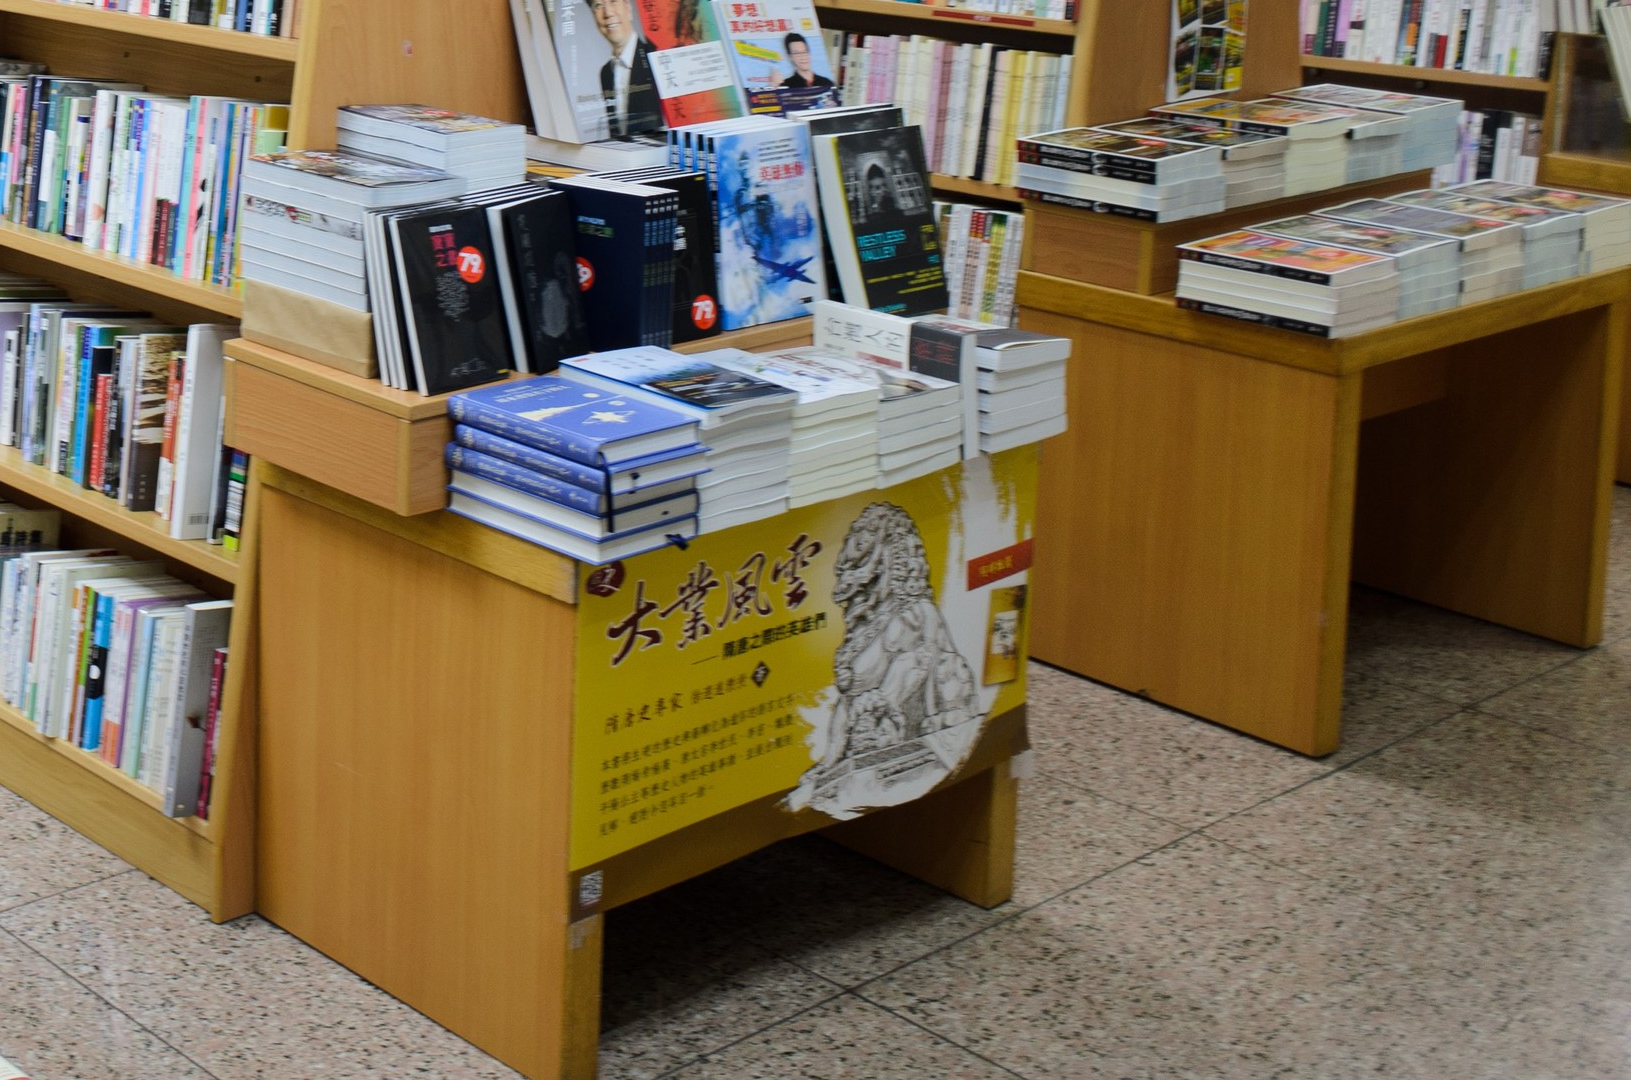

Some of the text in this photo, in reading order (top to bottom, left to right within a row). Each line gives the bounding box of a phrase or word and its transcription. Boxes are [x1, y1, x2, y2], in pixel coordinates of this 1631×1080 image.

[693, 300, 715, 321] 79
[606, 533, 823, 669] 大業風雲
